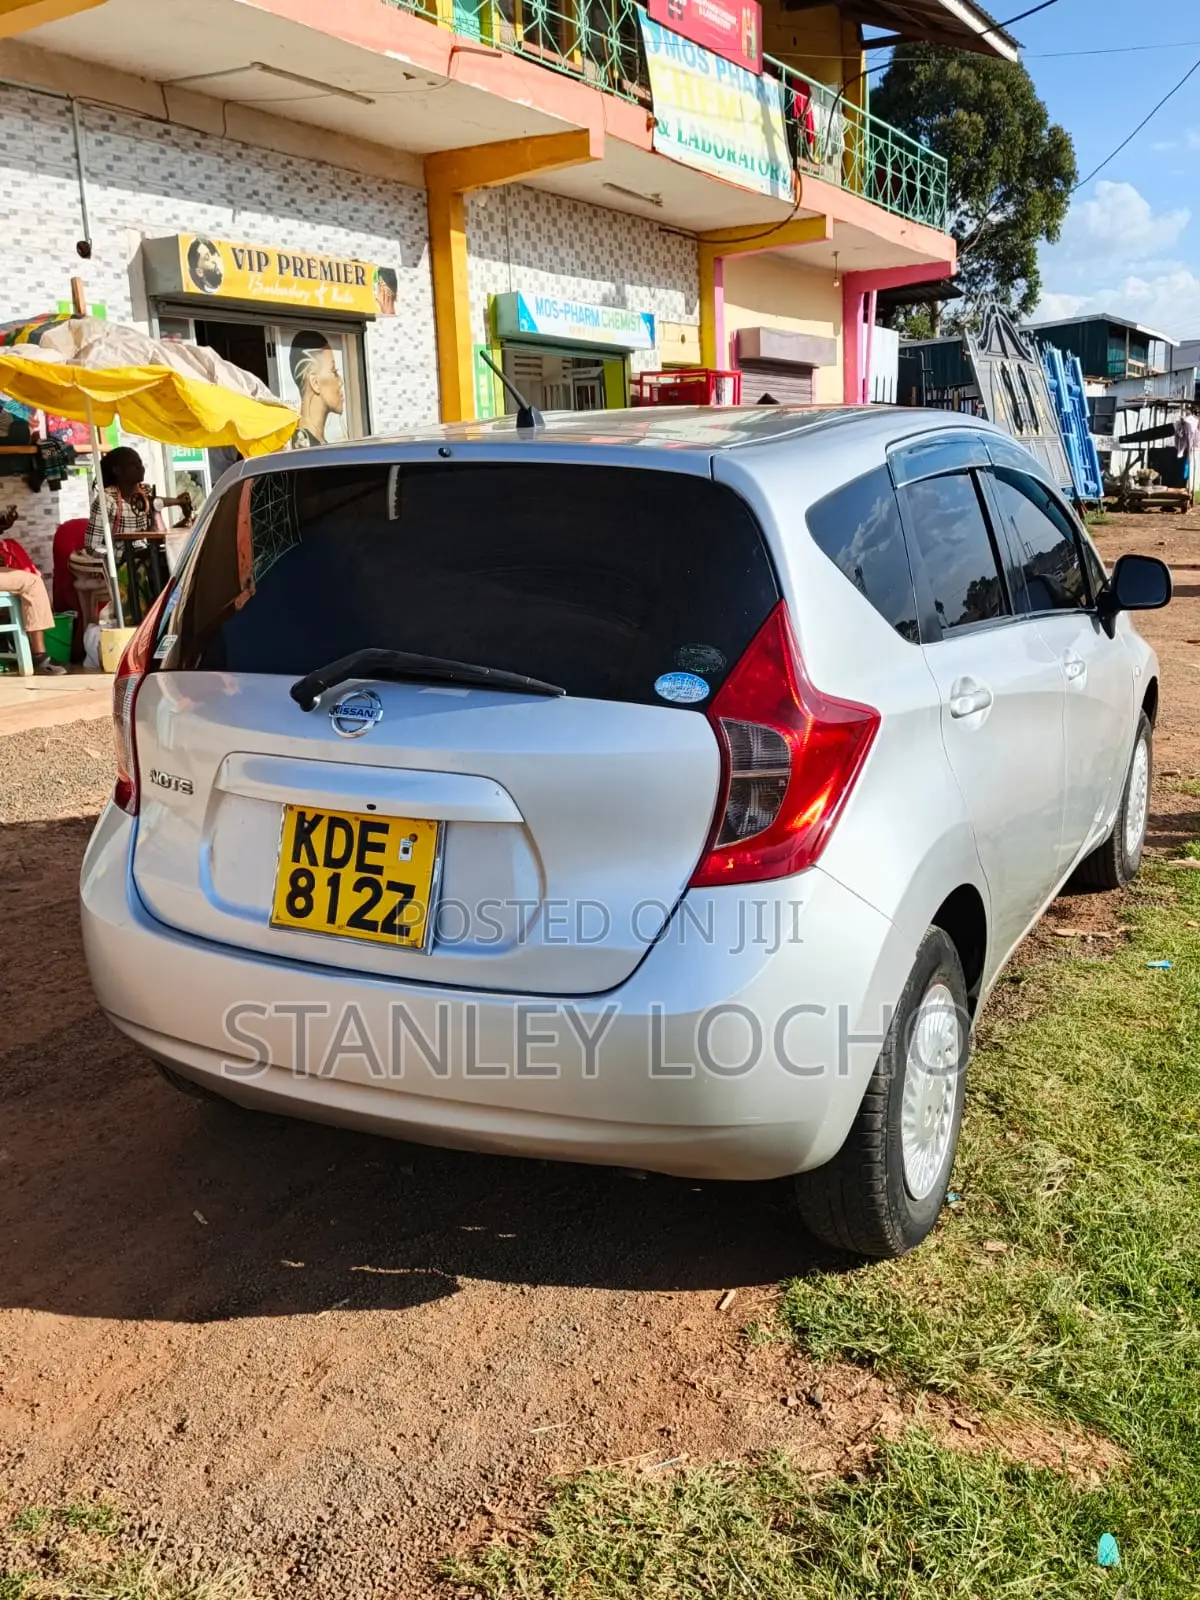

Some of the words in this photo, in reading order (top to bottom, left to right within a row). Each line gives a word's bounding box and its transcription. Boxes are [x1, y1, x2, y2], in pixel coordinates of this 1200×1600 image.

[231, 247, 270, 273] VIP
[277, 254, 367, 286] PREMIER
[535, 296, 600, 328] MOS-PHARM
[601, 309, 641, 332] CHEMIST
[331, 704, 375, 718] NISSAN
[150, 769, 194, 796] NOTE
[292, 811, 390, 876] KDE
[286, 867, 416, 937] 812Z
